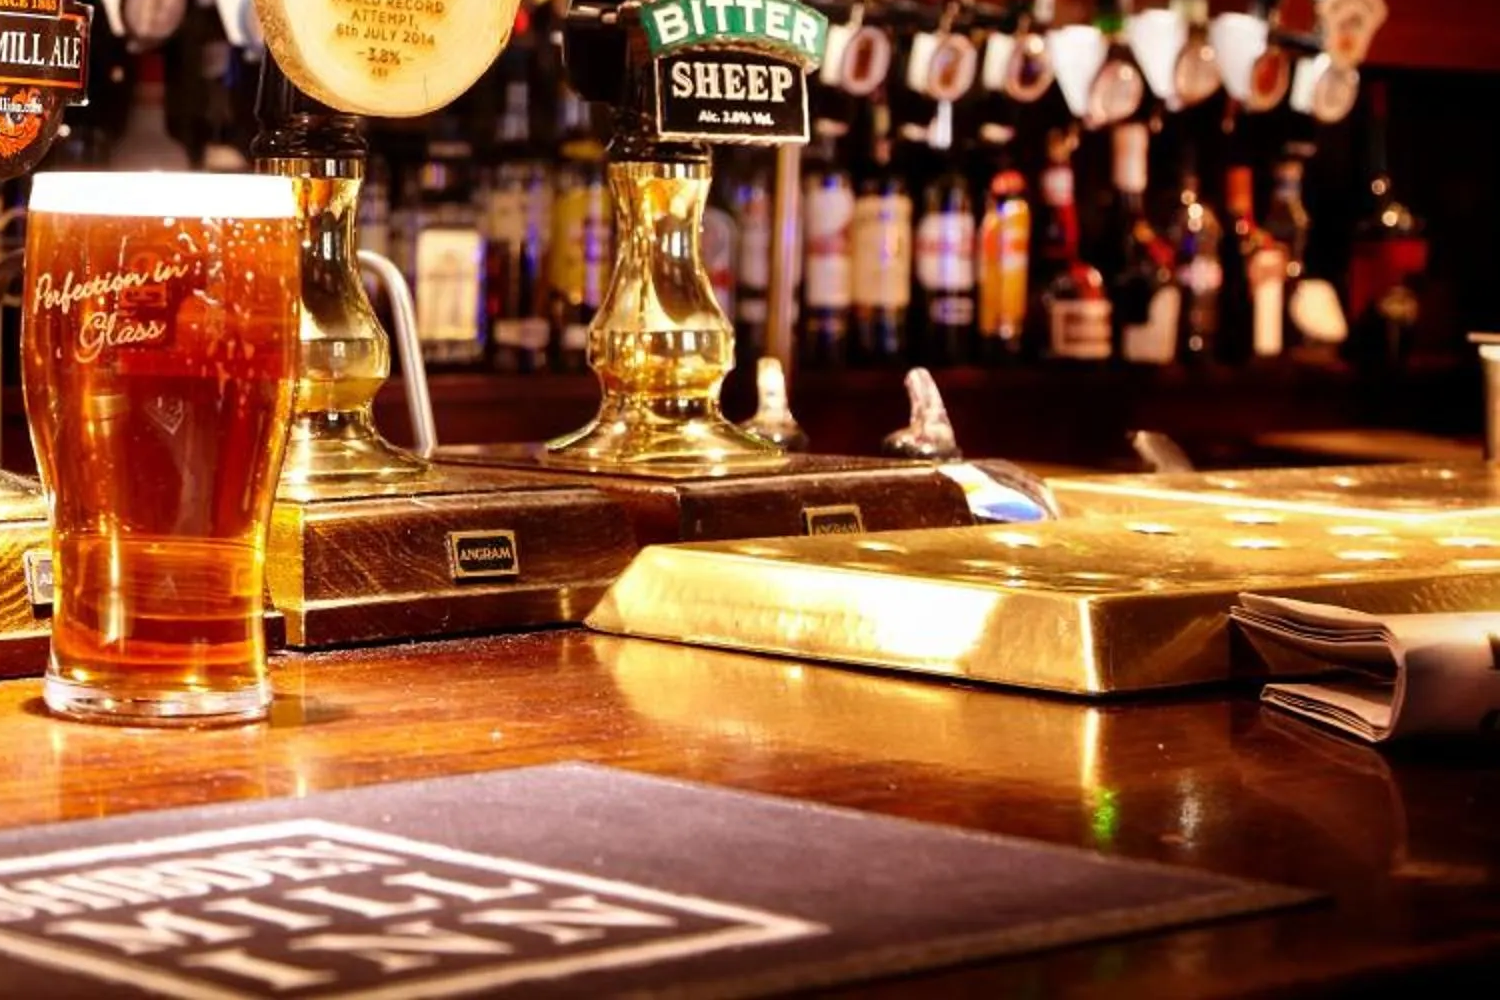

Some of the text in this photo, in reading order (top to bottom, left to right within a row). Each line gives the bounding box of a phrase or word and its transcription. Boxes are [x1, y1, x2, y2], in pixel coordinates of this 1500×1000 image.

[49, 35, 81, 69] ALE
[364, 27, 396, 41] JULY
[402, 31, 435, 46] 2014
[672, 62, 794, 102] SHEEP
[74, 310, 166, 363] Glass
[460, 547, 511, 561] ANGRAM
[44, 871, 543, 955] MILL
[180, 894, 679, 990] INN
